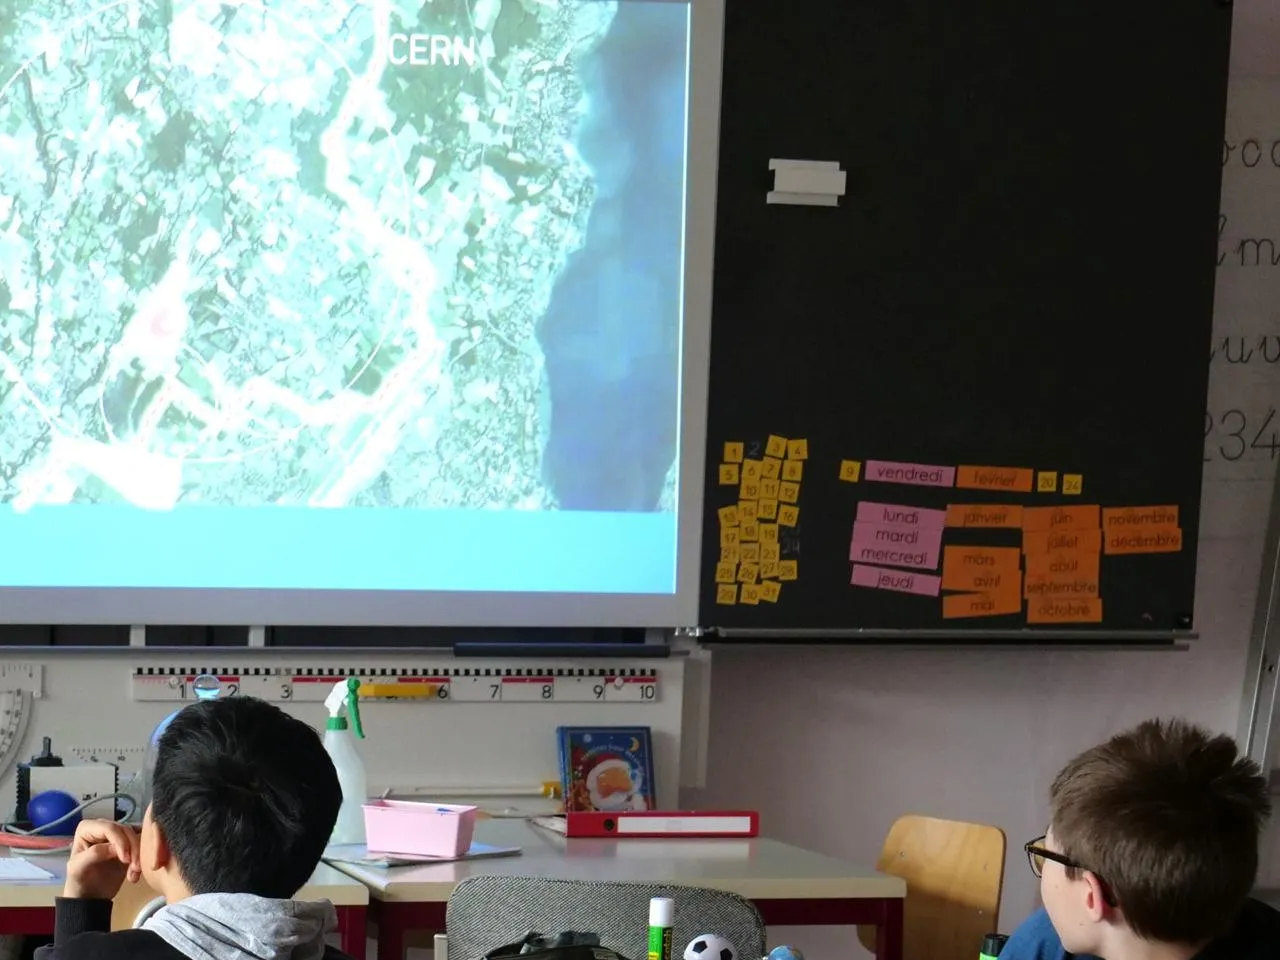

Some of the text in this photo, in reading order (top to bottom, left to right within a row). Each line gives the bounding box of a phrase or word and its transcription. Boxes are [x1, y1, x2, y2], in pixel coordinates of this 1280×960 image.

[388, 33, 475, 66] CERN
[877, 464, 943, 483] vendredi
[882, 508, 919, 525] lundi
[963, 511, 1008, 527] janvier
[1050, 510, 1073, 528] juin
[1108, 509, 1176, 525] novembre
[875, 529, 919, 545] mardi
[861, 548, 928, 566] mercredi
[963, 555, 996, 566] mars
[877, 571, 915, 590] jeudi
[973, 574, 1001, 588] avril
[1026, 580, 1097, 596] septembre
[970, 600, 996, 611] mai
[1038, 602, 1091, 617] octobre
[226, 684, 239, 697] 2
[280, 684, 292, 699] 3
[437, 684, 448, 699] 6
[489, 684, 500, 699] 7
[541, 684, 553, 699] 8
[593, 684, 604, 699] 9
[639, 684, 655, 699] 10
